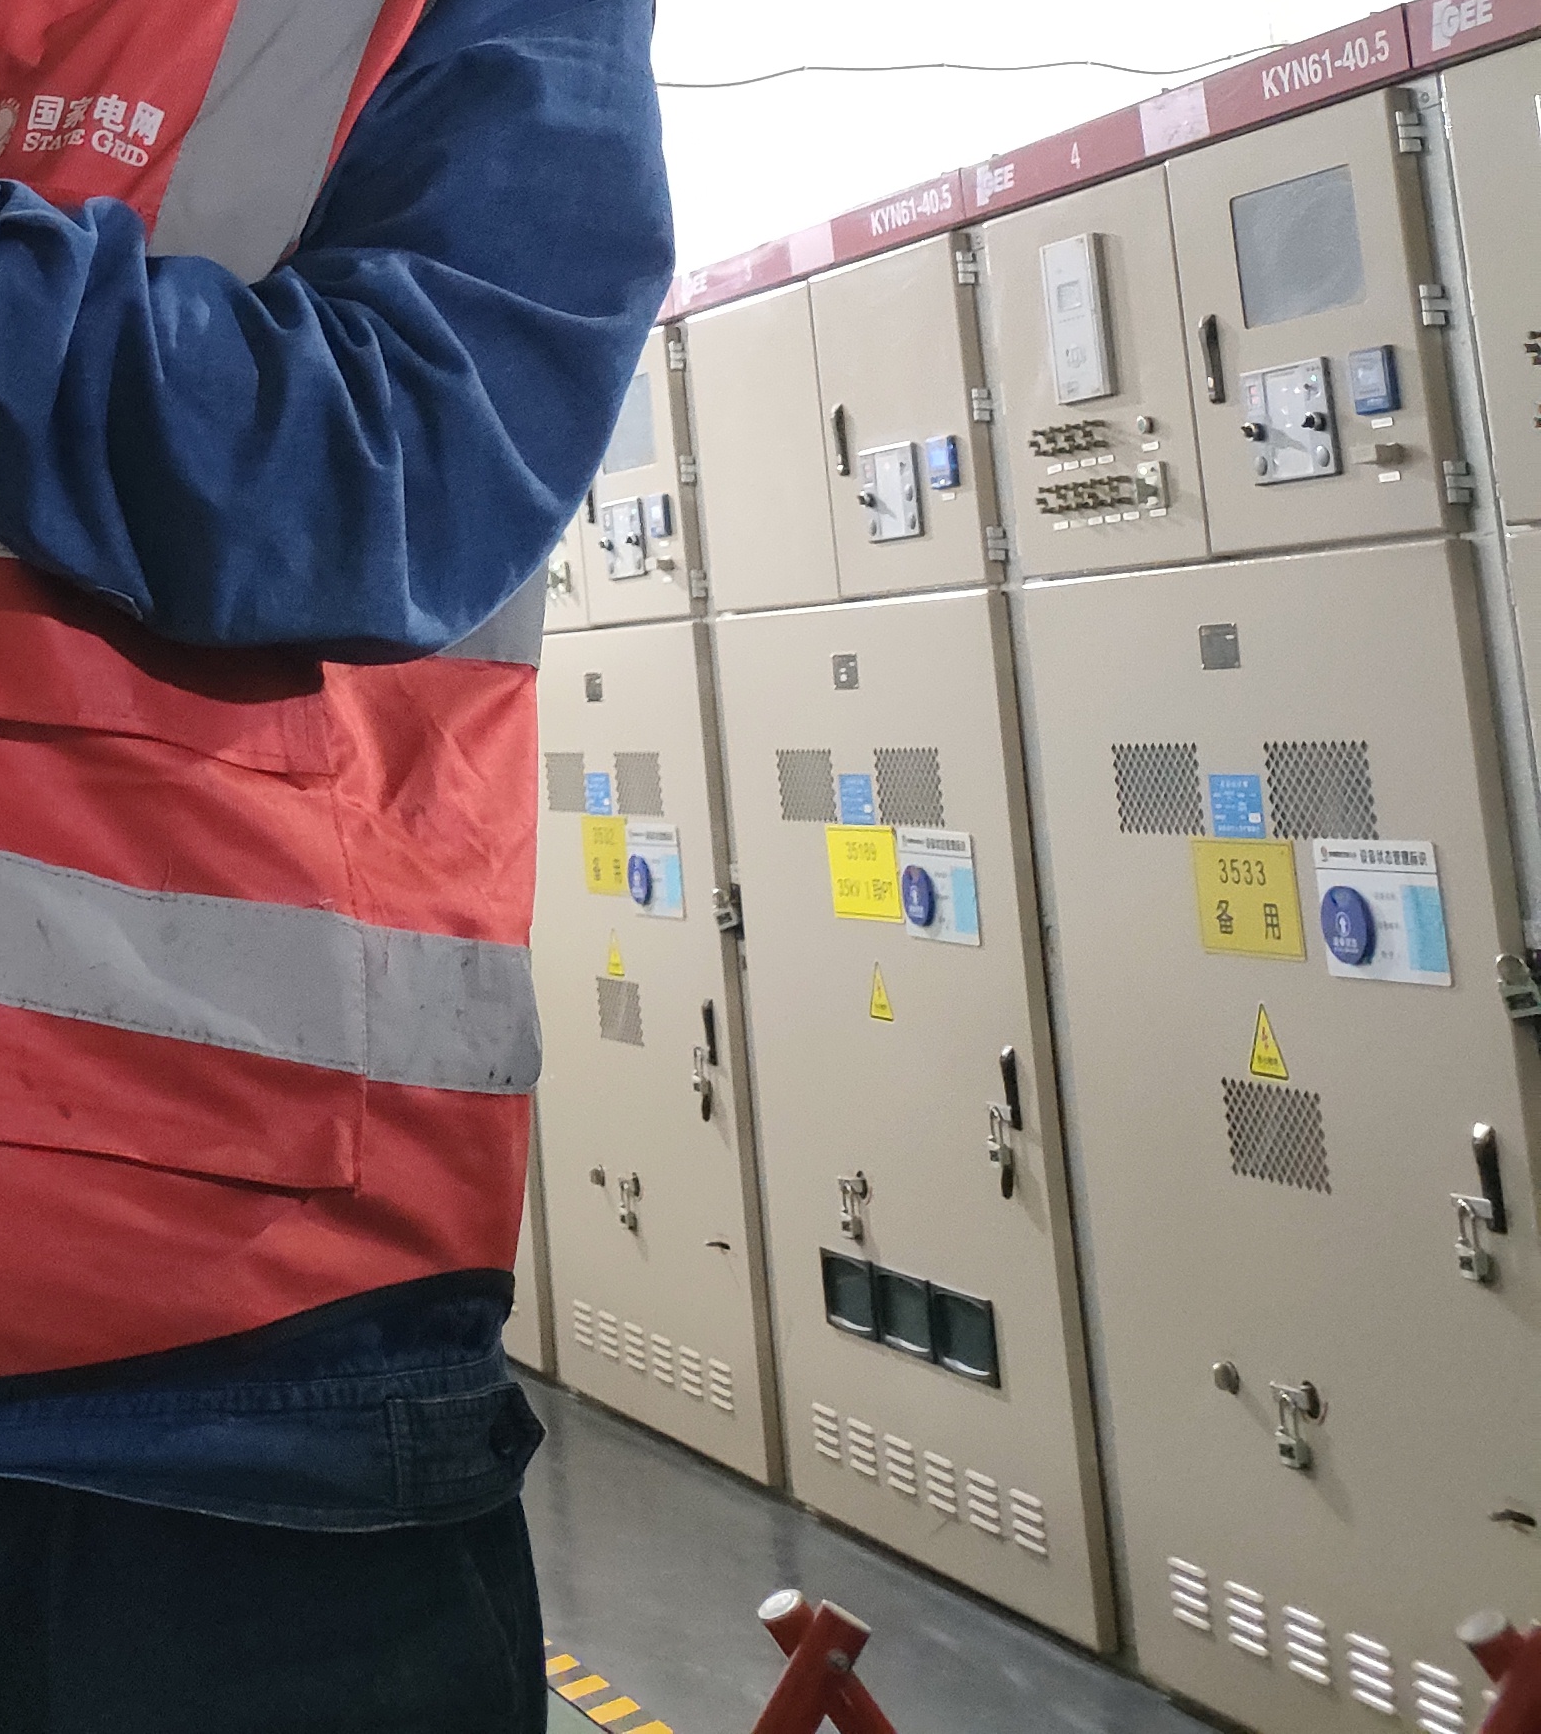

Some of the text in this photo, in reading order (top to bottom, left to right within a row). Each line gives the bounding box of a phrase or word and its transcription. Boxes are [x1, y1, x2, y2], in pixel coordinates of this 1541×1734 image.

[1261, 30, 1390, 100] KYN61-40.5
[26, 94, 165, 146] 国家电网
[1070, 141, 1082, 170] 4
[870, 183, 952, 237] KYN61-40.5
[1218, 858, 1267, 886] 3533
[1215, 899, 1281, 940] 备用
